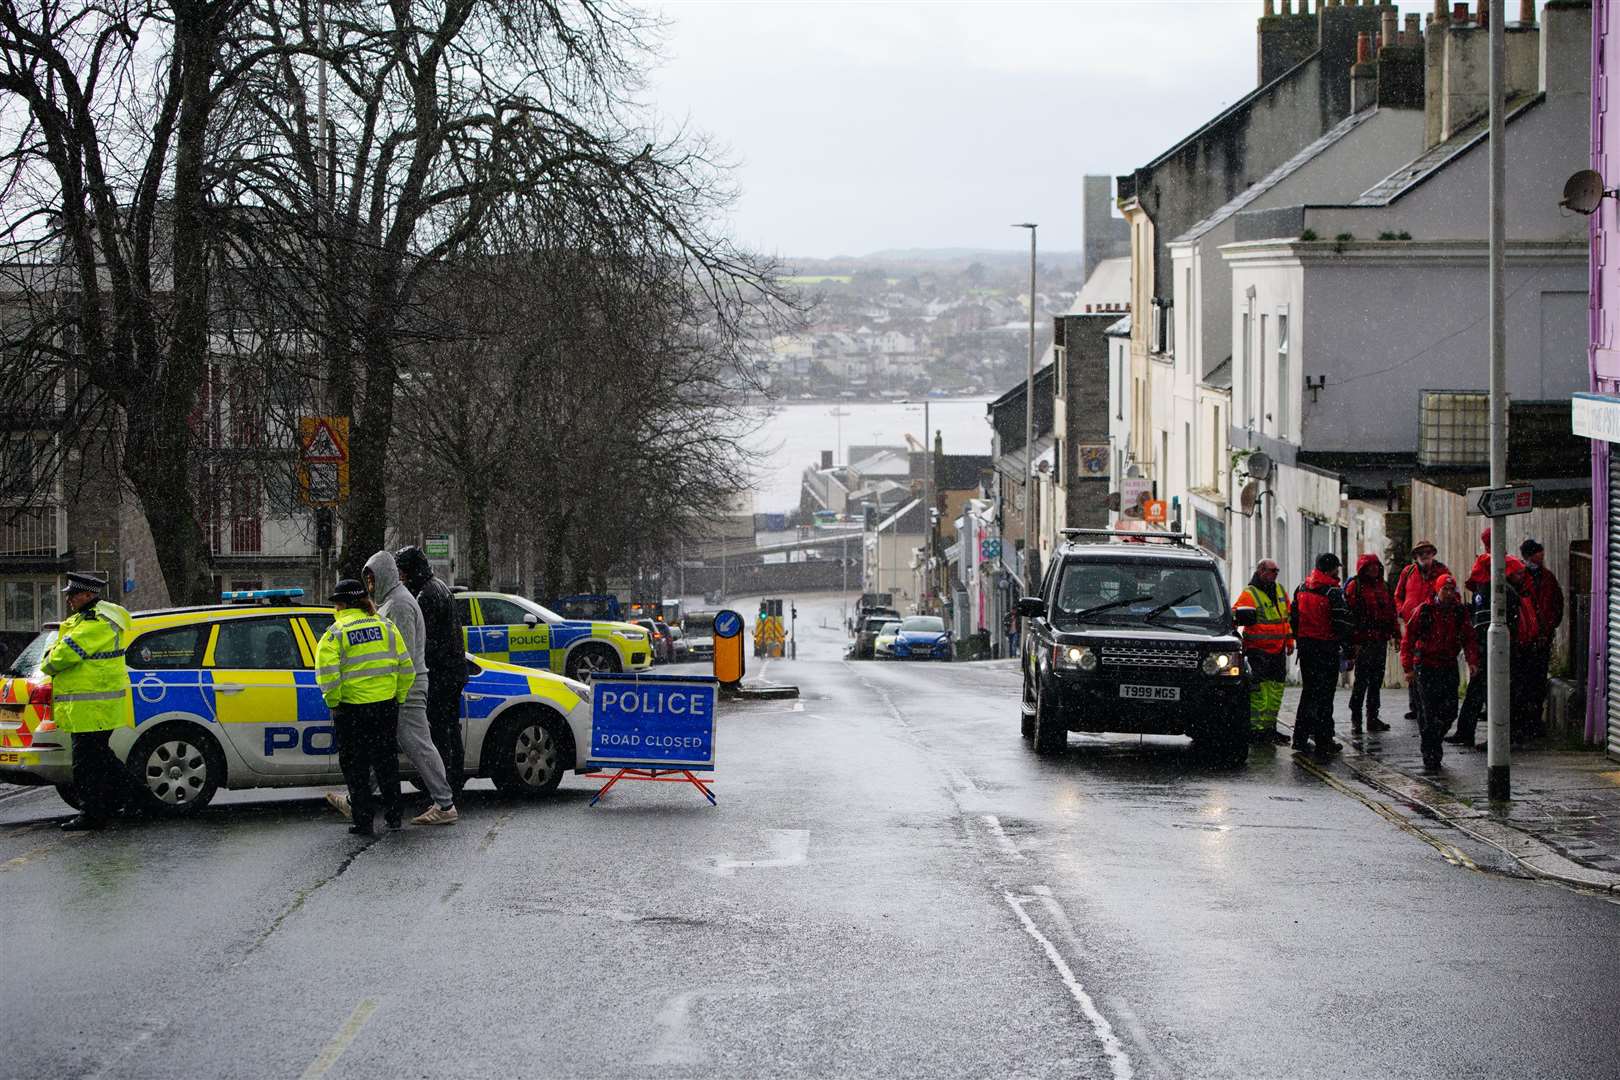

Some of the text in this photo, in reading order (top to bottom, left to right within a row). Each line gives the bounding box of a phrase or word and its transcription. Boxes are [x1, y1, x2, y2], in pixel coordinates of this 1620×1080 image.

[350, 627, 381, 644] POLICE
[510, 635, 548, 645] POLICE
[1124, 686, 1176, 699] T999 MGS
[601, 691, 705, 715] POLICE
[601, 734, 702, 748] ROAD CLOSED
